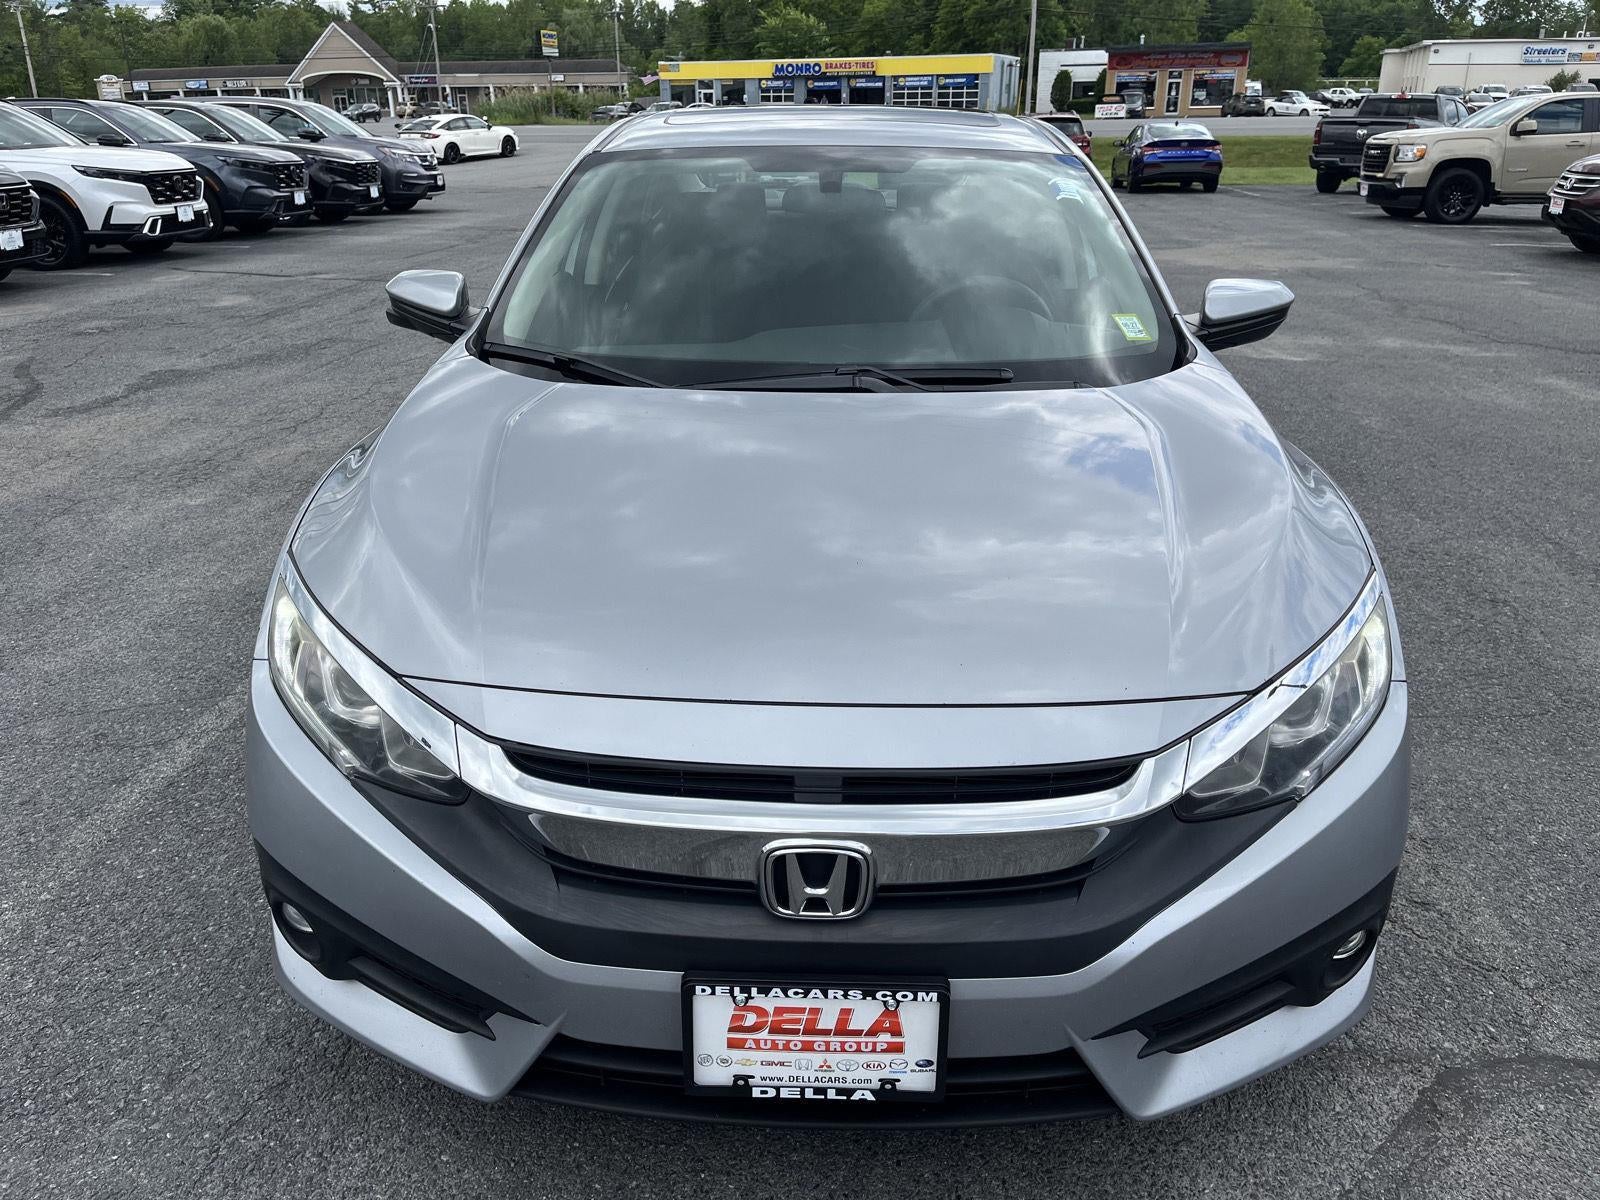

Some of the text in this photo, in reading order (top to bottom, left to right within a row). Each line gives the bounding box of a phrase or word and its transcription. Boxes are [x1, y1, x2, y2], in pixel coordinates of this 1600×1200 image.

[1523, 46, 1567, 55] Streeters
[774, 63, 822, 76] MONRO
[695, 985, 938, 1002] DELLACARS.COM
[727, 1004, 905, 1038] DELLA
[744, 1038, 888, 1053] AUTO GROUP
[760, 1060, 884, 1070] GMC KIA
[760, 1075, 872, 1085] www.DELLACARS.com
[751, 1087, 876, 1101] DELLA
